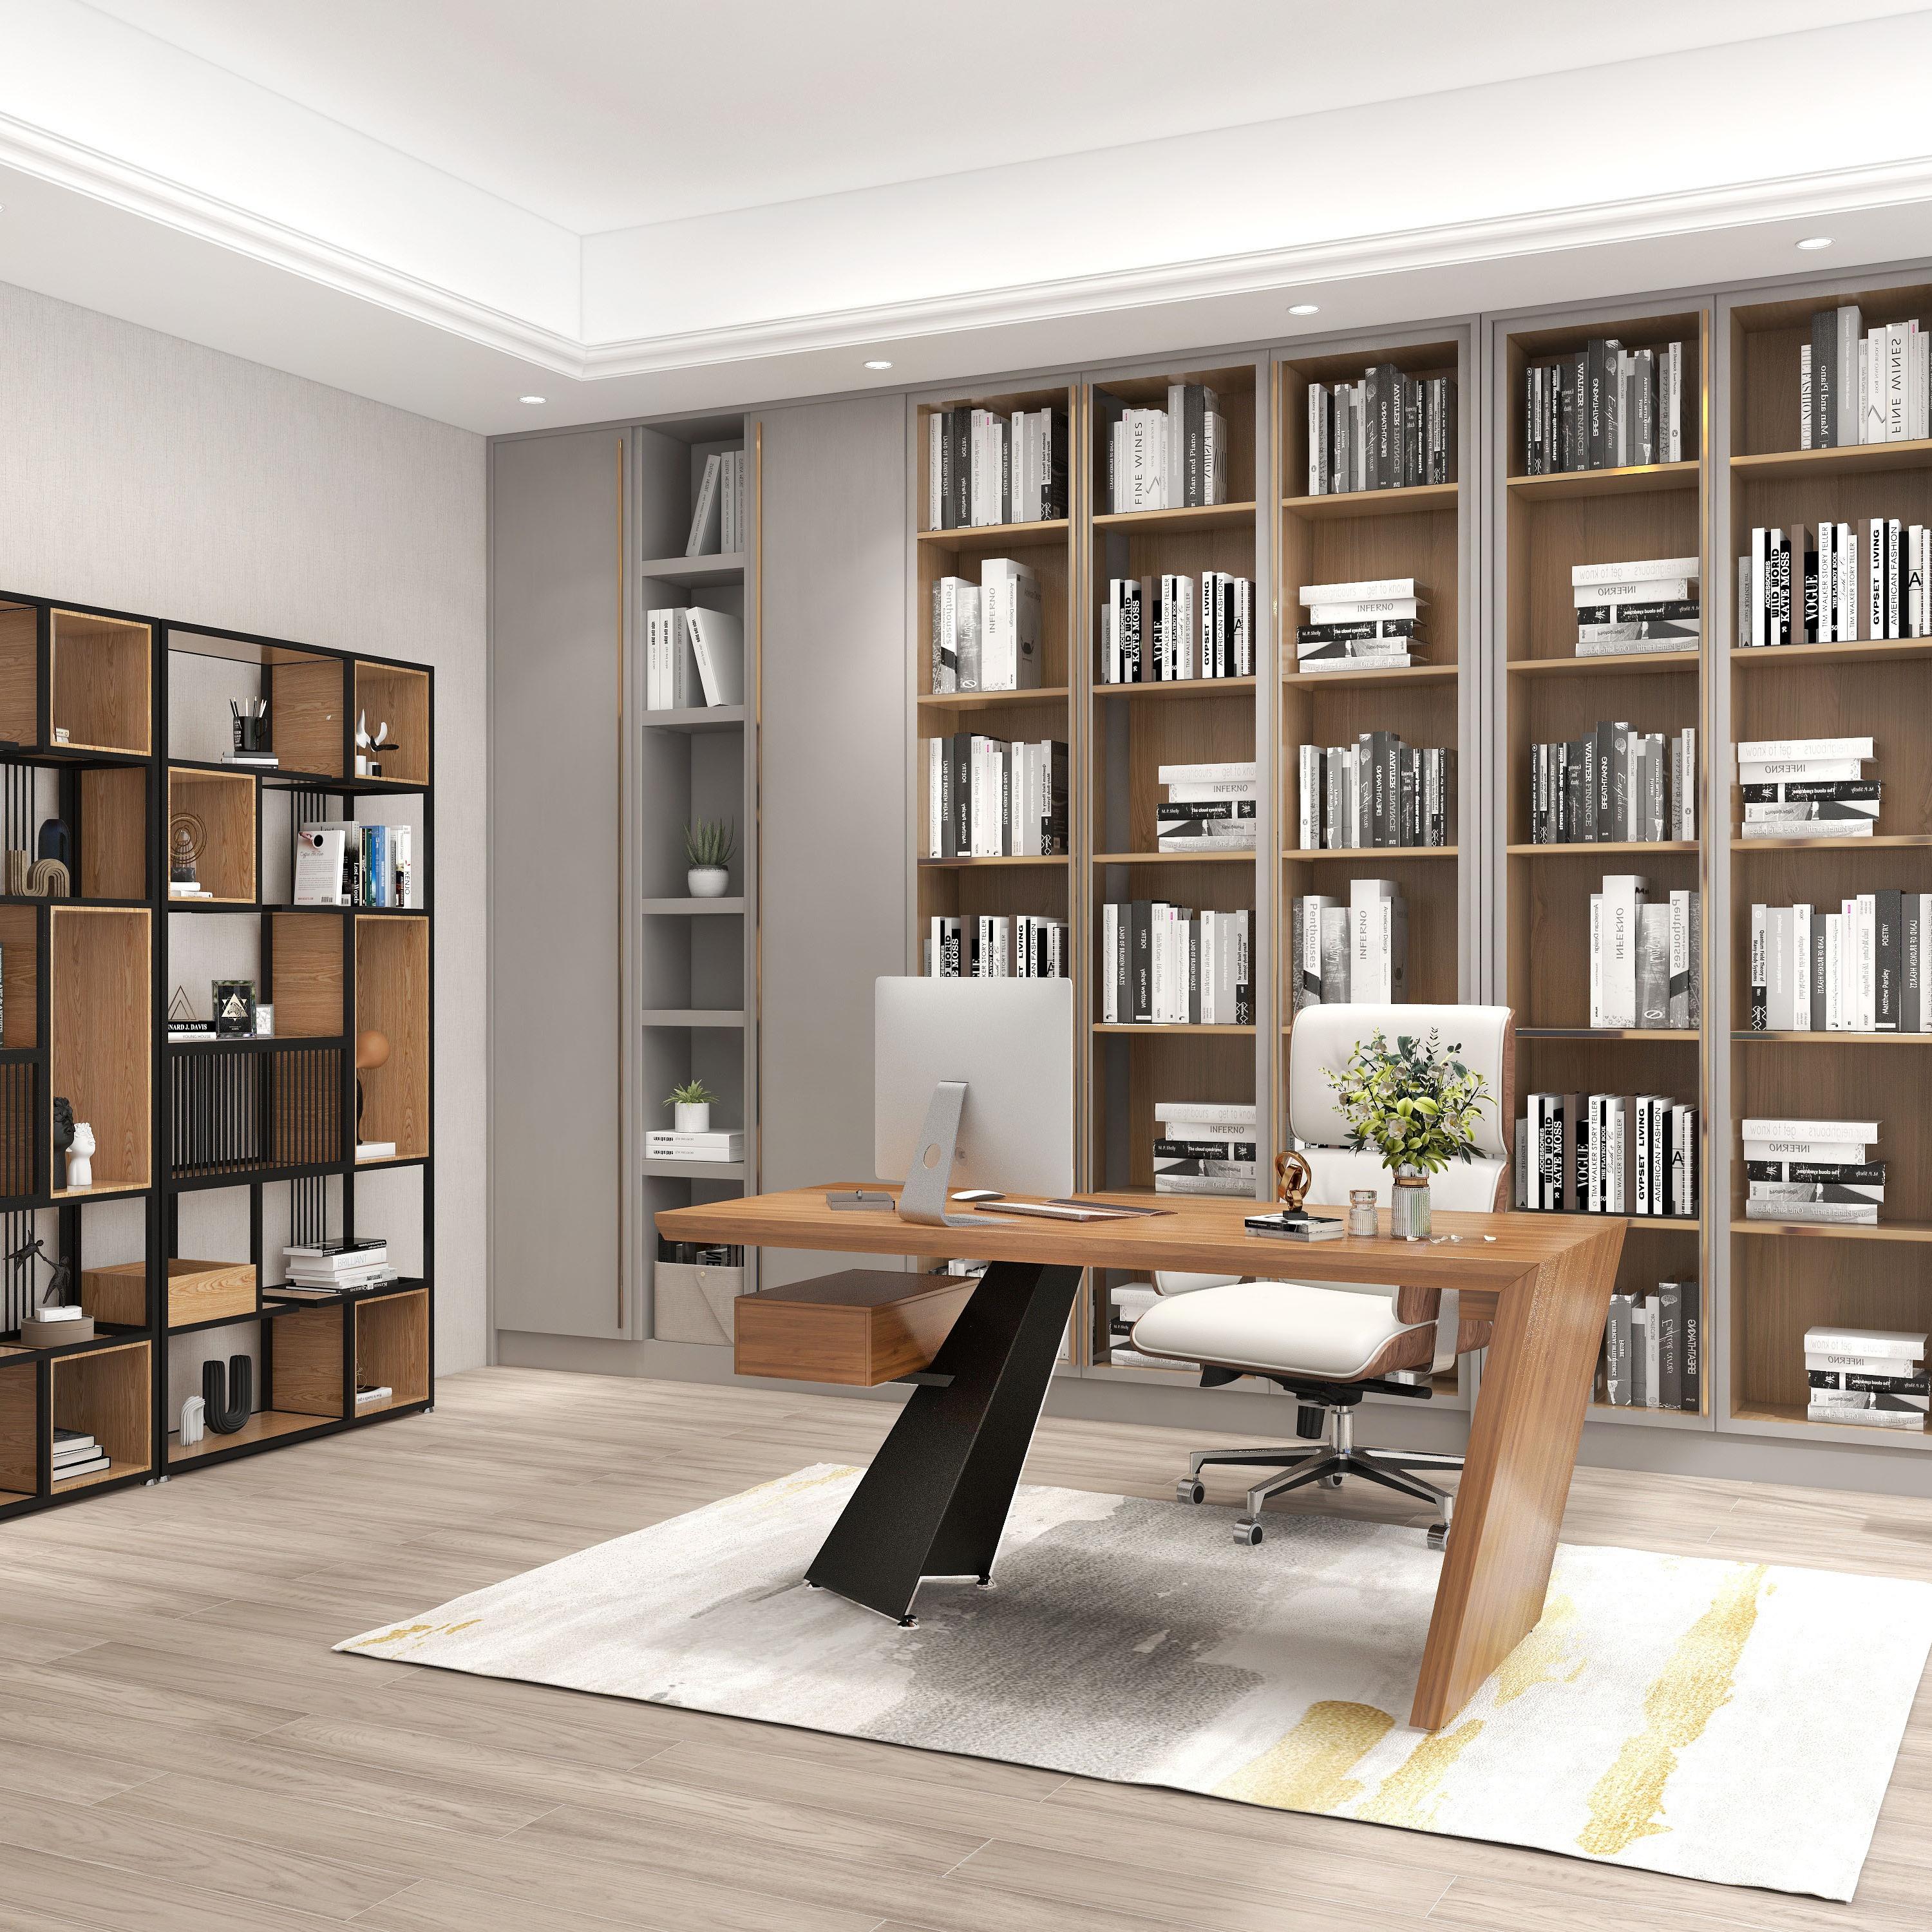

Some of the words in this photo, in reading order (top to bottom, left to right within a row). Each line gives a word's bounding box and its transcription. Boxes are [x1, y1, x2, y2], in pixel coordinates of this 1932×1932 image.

[1803, 372, 1812, 420] FASHION
[1604, 395, 1618, 431] English
[1771, 548, 1780, 588] WORLD
[1780, 551, 1790, 587] MOSS
[945, 583, 954, 645] Penthouses
[1358, 603, 1394, 612] INFERNO
[1771, 591, 1780, 618] WILD
[1780, 589, 1790, 623] KATE
[1805, 574, 1819, 622] VOGUE
[1132, 600, 1140, 631] MOSS
[1153, 620, 1162, 662] VOGUE
[1214, 784, 1248, 793] INFERNO
[1309, 903, 1318, 968] Penthouses
[1880, 923, 1889, 946] POETRY
[1880, 969, 1891, 989] Parsley
[1881, 989, 1891, 1015] Matthew
[1210, 1126, 1245, 1134] INFERNO
[1553, 1121, 1562, 1155] MOSS
[1553, 1156, 1562, 1189] KATE
[1577, 1144, 1589, 1188] VOGUE
[1238, 1182, 1253, 1191] place
[337, 1255, 368, 1267] BRILLIANT
